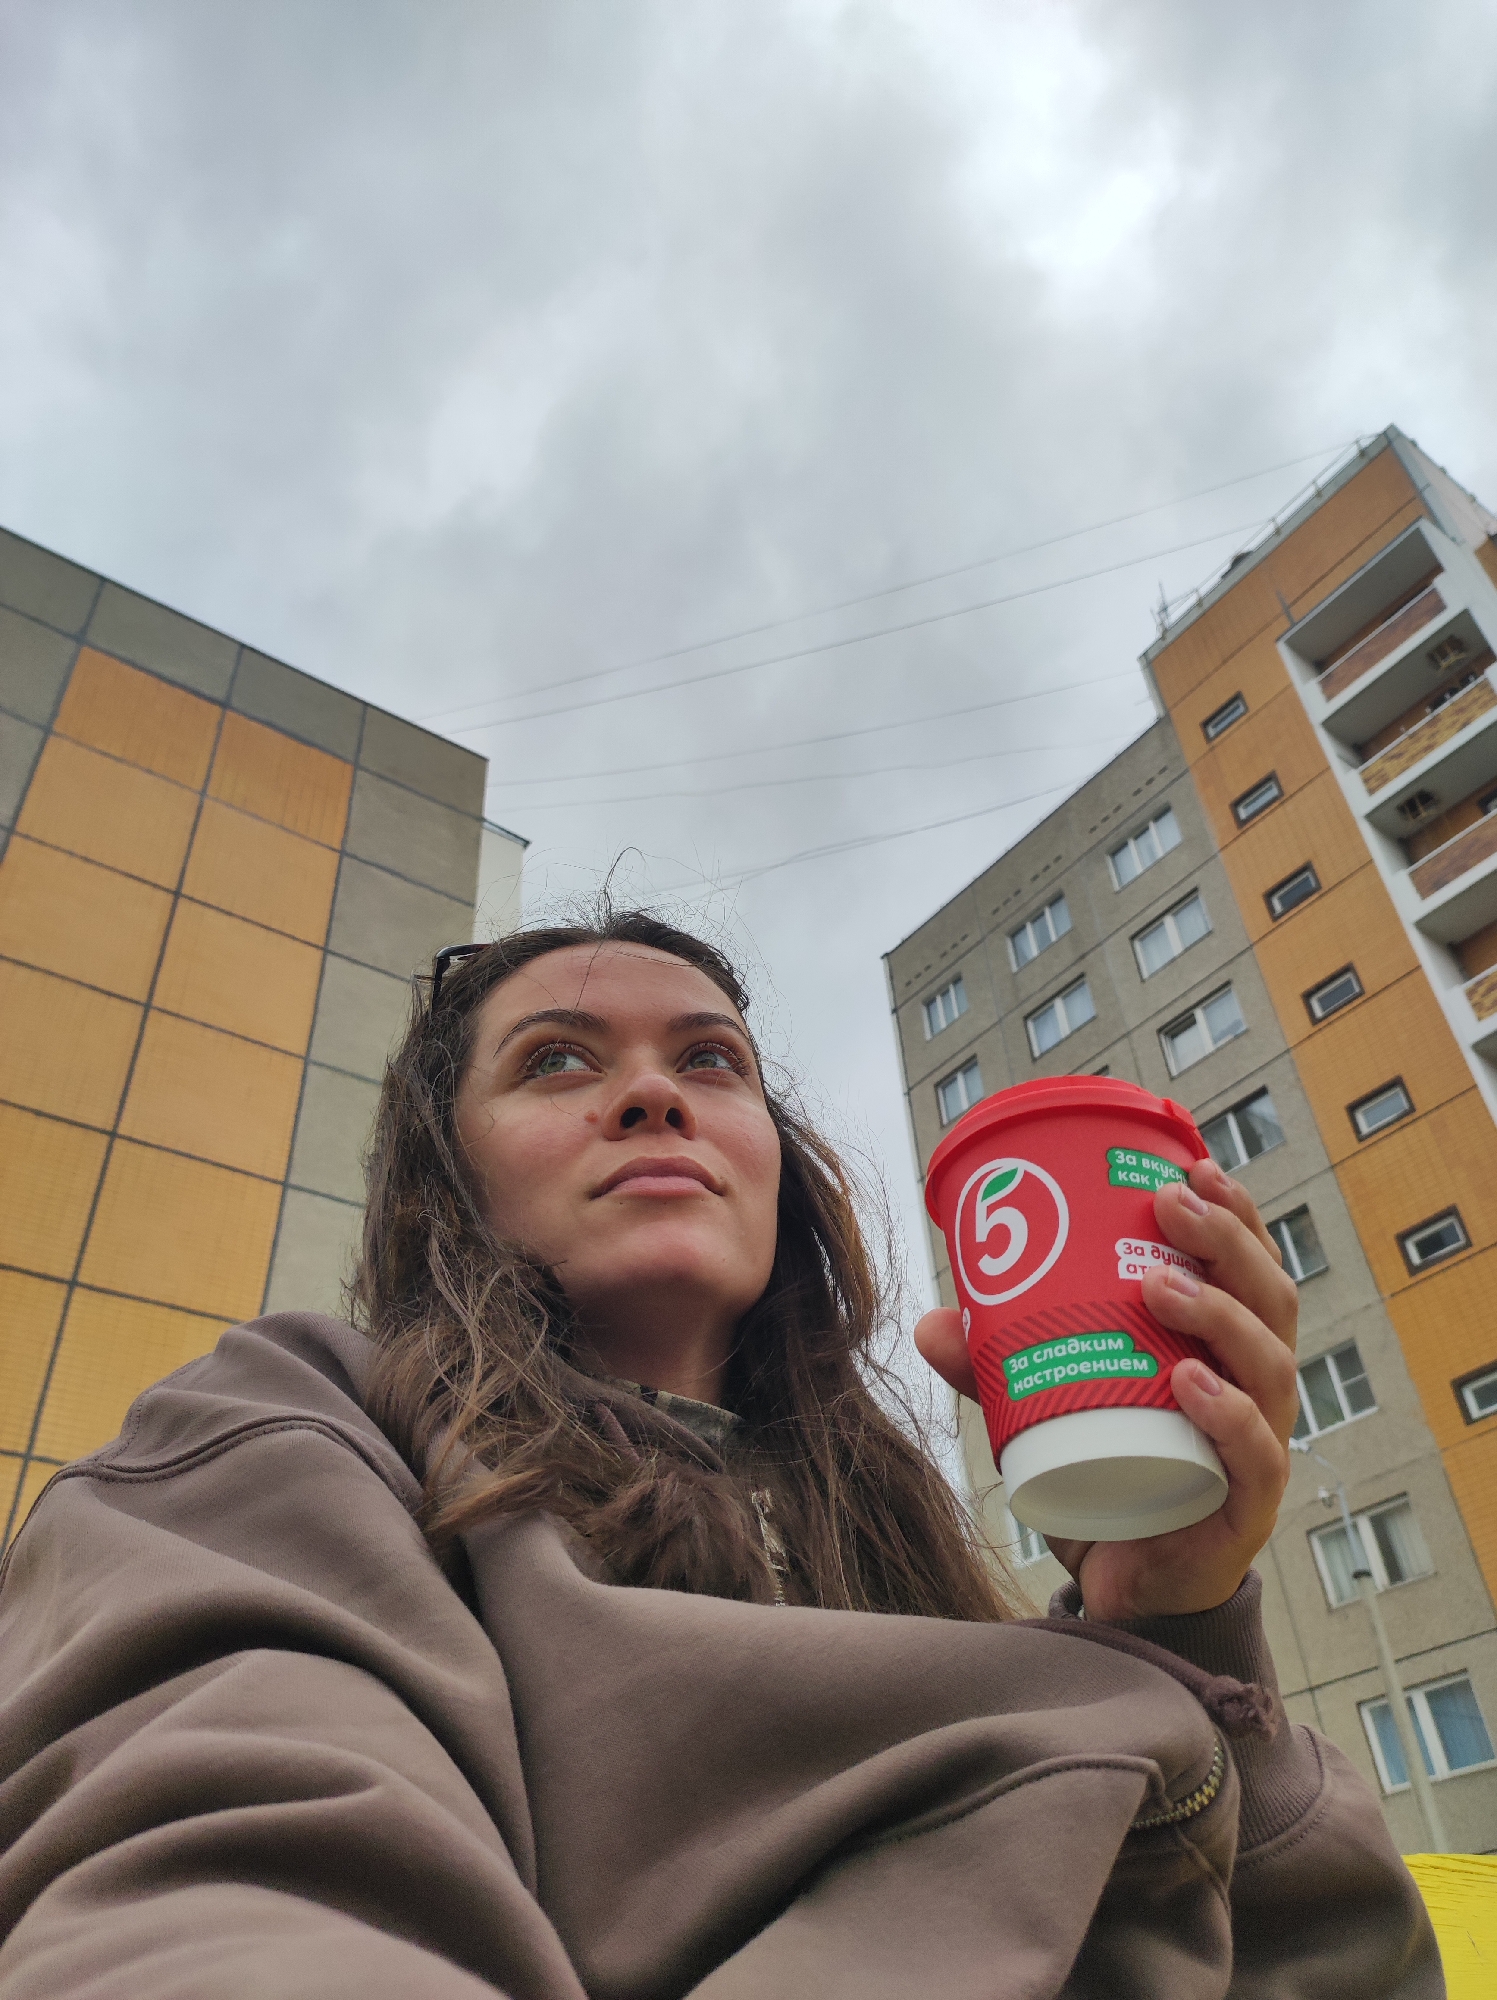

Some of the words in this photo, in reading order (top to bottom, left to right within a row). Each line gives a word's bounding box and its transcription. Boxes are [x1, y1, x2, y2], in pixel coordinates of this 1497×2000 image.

[1115, 1150, 1137, 1166] За
[1118, 1170, 1150, 1186] как
[976, 1166, 1028, 1276] 5
[1122, 1242, 1146, 1257] За
[1008, 1355, 1029, 1374] За
[1032, 1338, 1125, 1364] сладким
[1013, 1357, 1149, 1394] настроением
